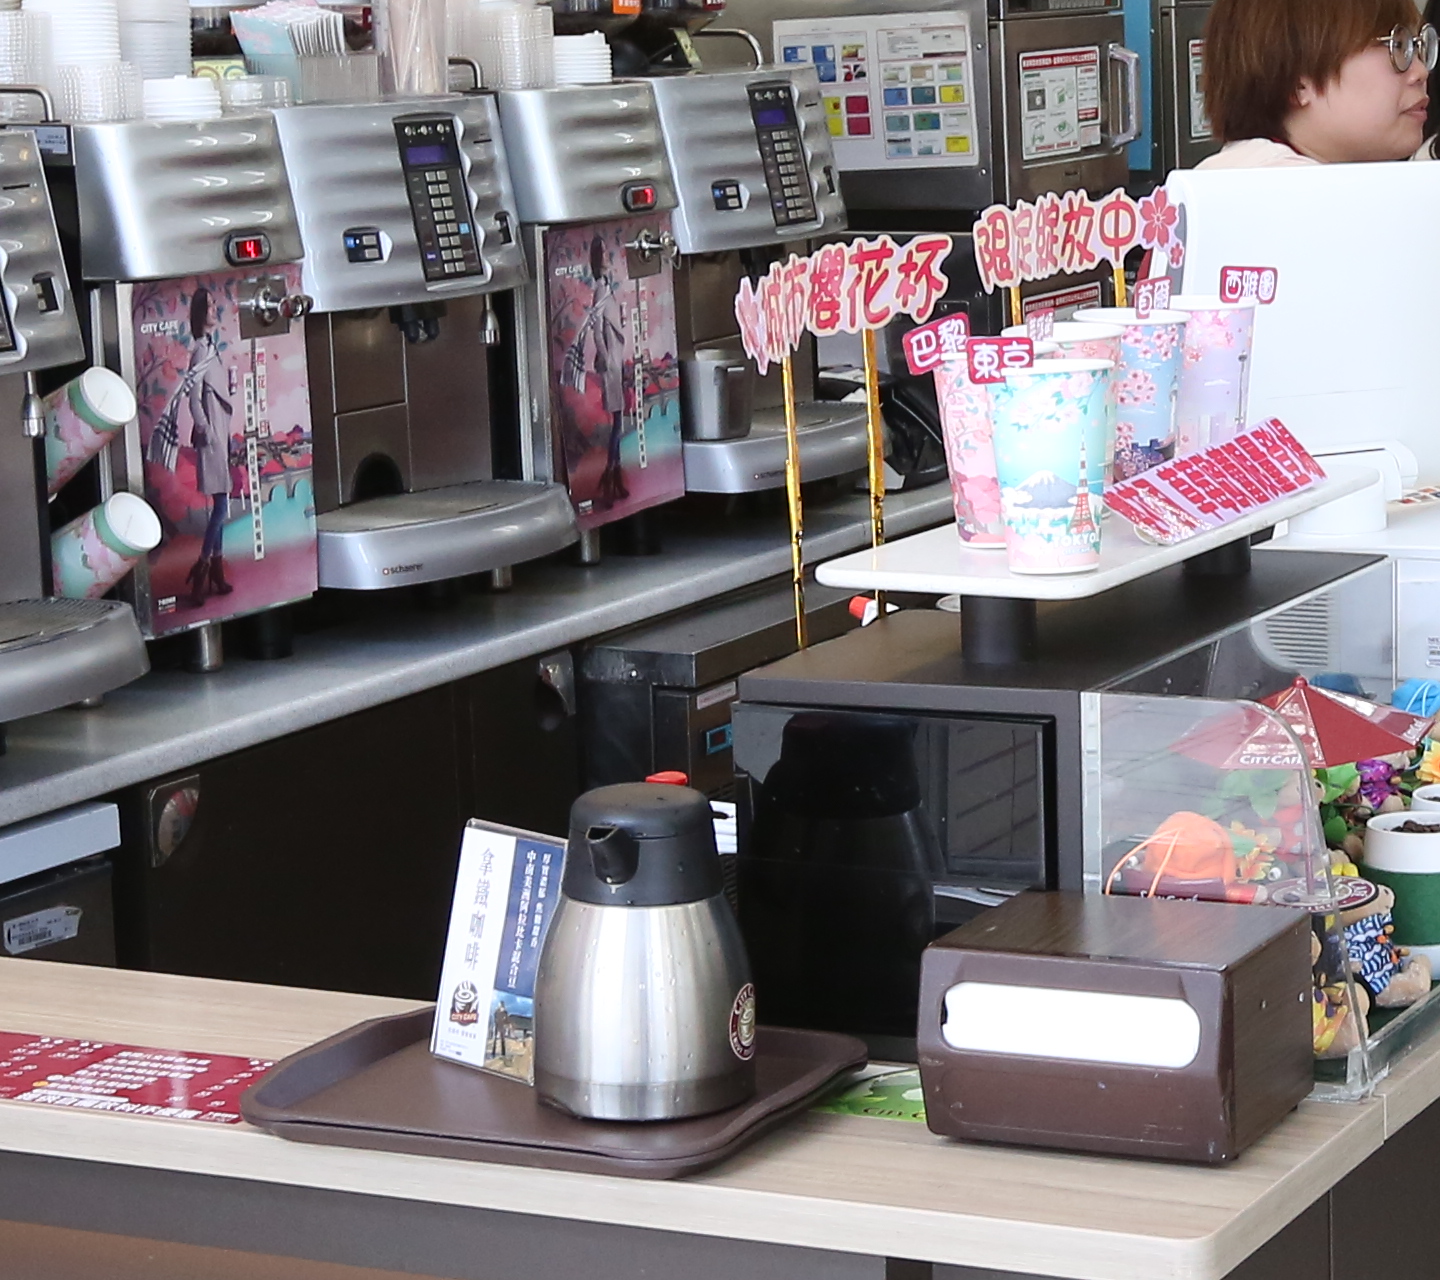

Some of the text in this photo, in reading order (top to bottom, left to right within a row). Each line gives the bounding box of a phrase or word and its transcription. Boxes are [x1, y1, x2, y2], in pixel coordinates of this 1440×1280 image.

[976, 193, 1138, 286] 限定綻放中
[758, 235, 948, 356] 城市櫻花杯
[1137, 281, 1171, 316] 首爾
[1223, 269, 1278, 298] 西雅圖
[140, 319, 179, 334] CITY CAFE
[910, 318, 967, 370] 巴黎
[971, 339, 1032, 382] 東京
[1052, 531, 1097, 548] TOKYO
[1239, 754, 1269, 766] CITY
